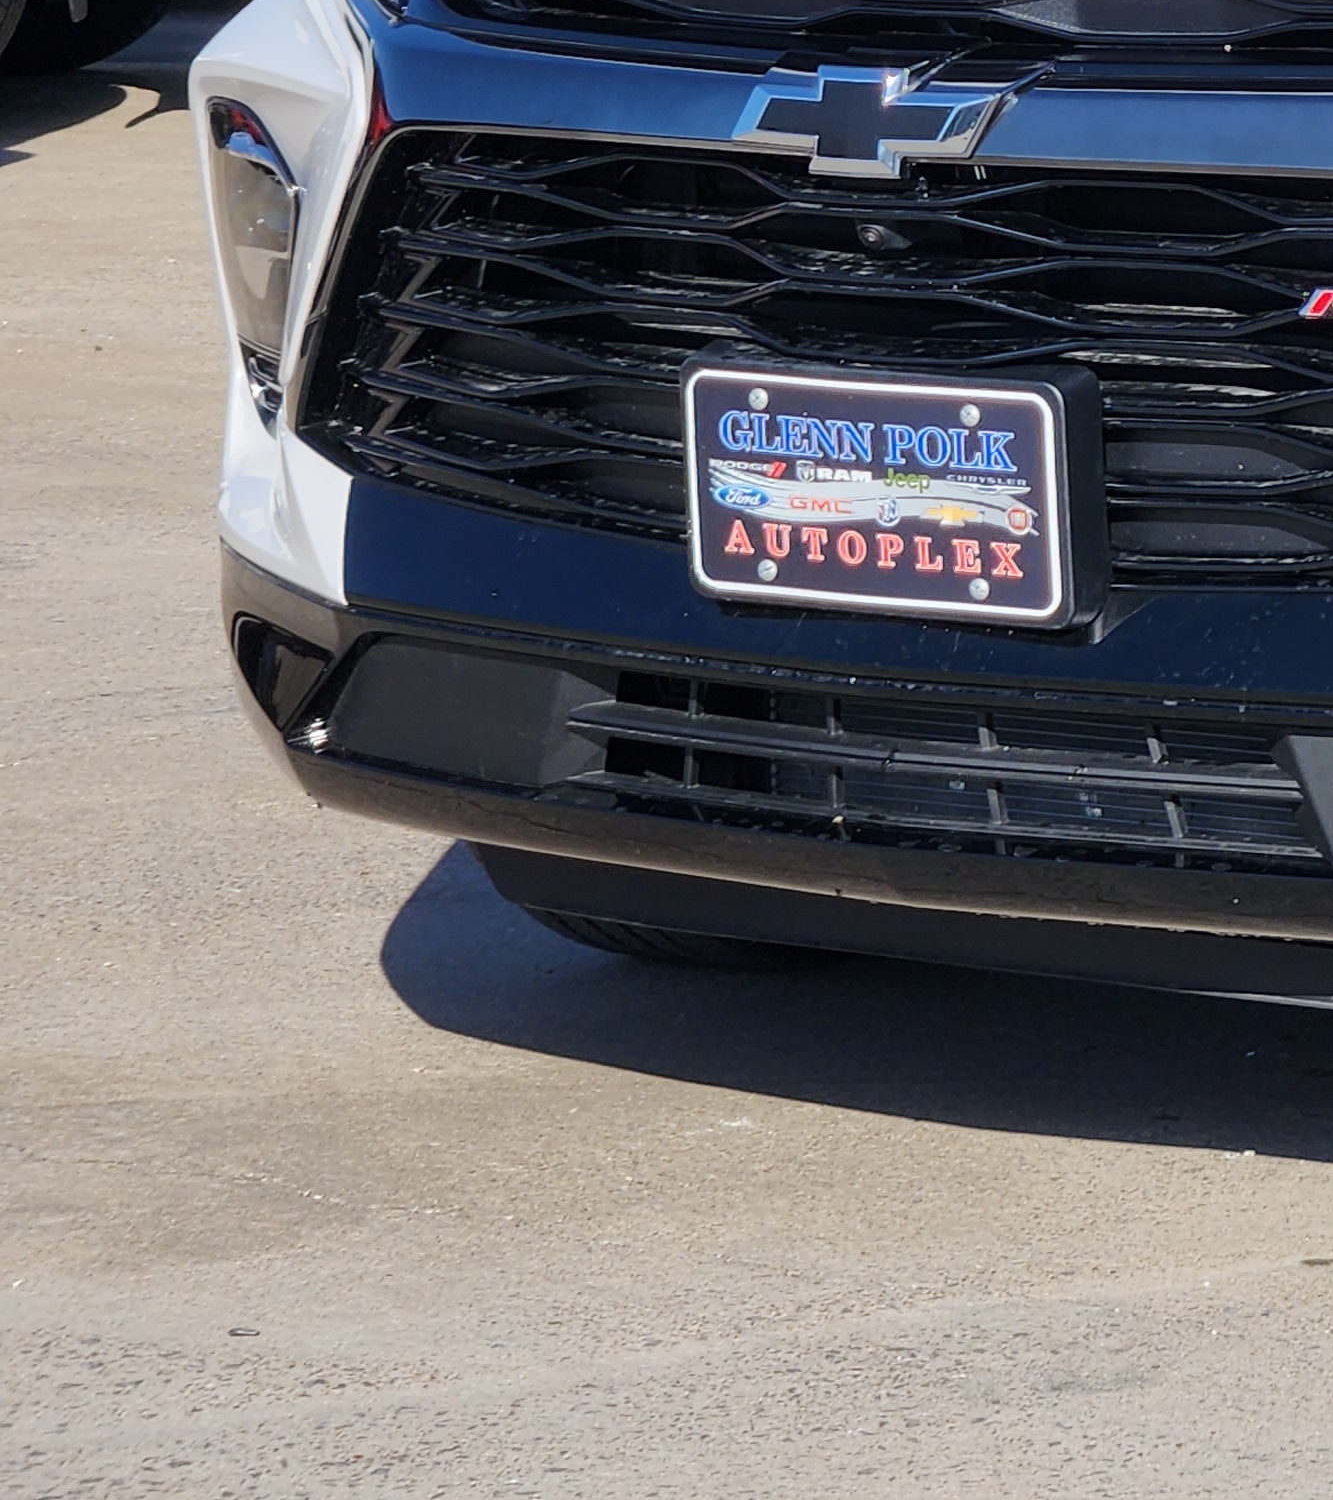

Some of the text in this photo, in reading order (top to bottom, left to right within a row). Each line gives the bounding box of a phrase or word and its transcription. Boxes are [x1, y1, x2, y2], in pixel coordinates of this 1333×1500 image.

[718, 410, 1019, 473] GLENN POLK
[708, 458, 774, 471] DODGE
[816, 467, 873, 483] RAM
[884, 467, 931, 494] Jeep
[946, 474, 1027, 487] CHRYSLER
[725, 486, 762, 507] Ford
[789, 495, 855, 514] GMC
[723, 518, 1025, 580] AUTOPLEX
